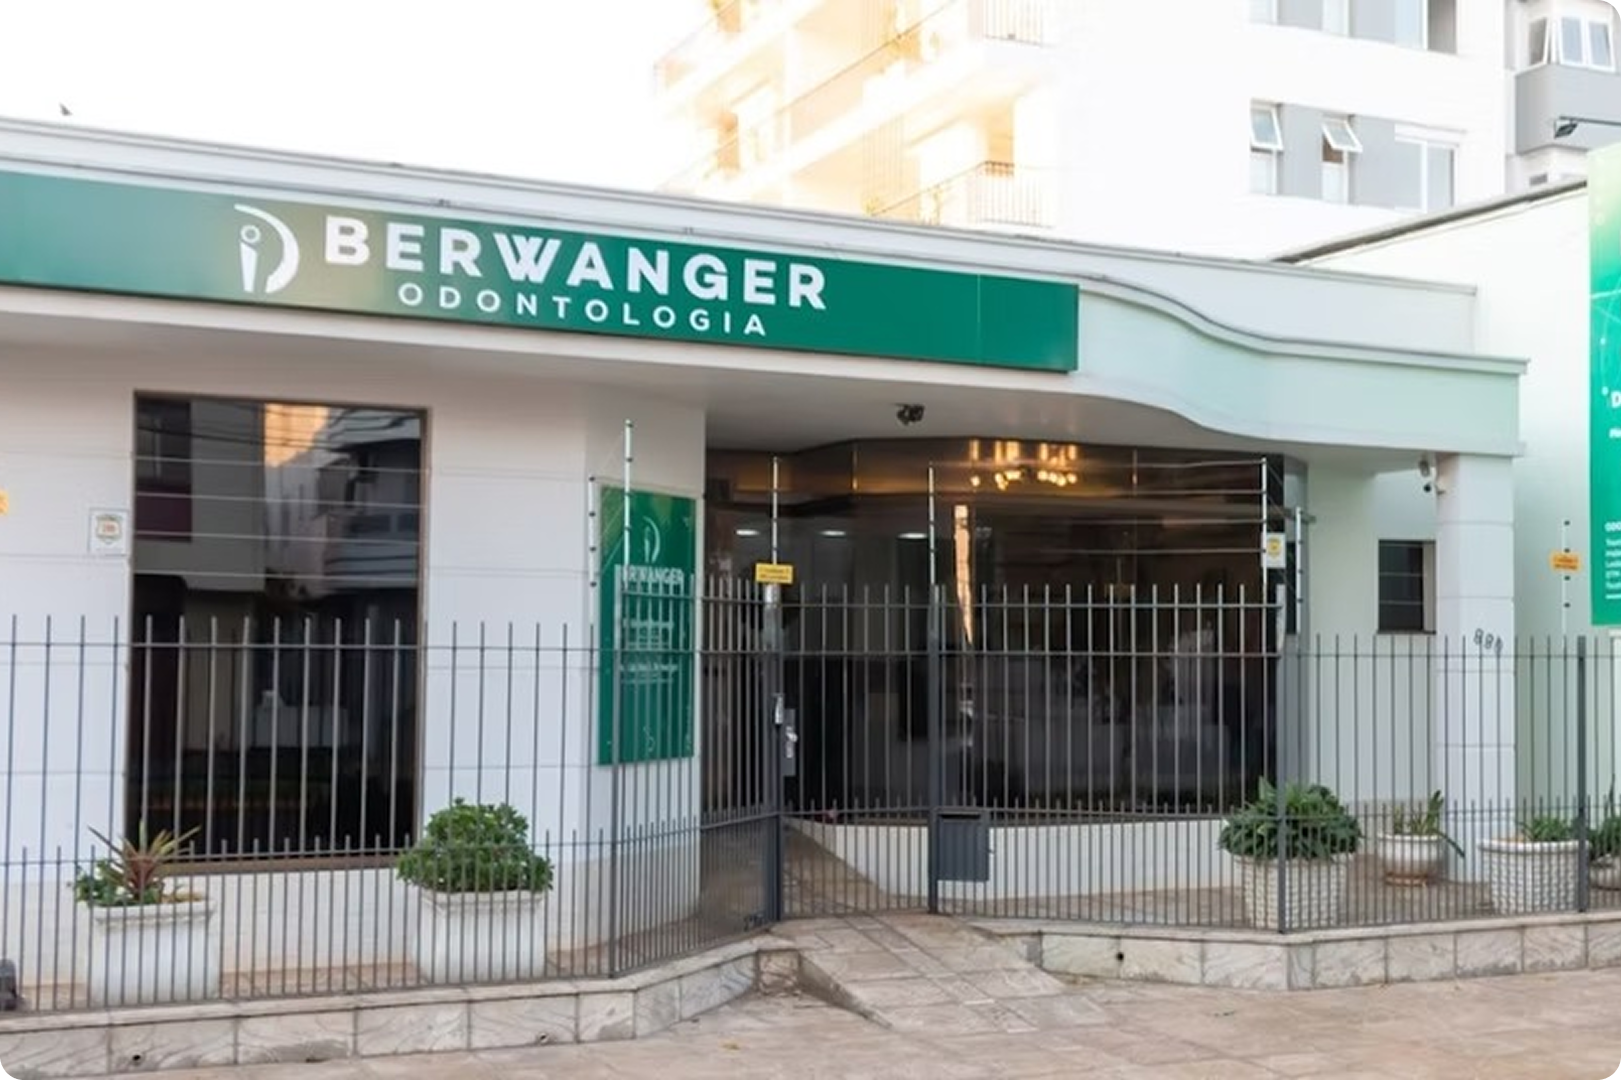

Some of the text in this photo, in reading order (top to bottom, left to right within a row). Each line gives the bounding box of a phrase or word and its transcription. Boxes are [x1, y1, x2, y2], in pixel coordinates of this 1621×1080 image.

[325, 216, 826, 310] BERWANGER
[398, 283, 766, 336] ODONTOLOGIA
[614, 564, 685, 584] RWANGER
